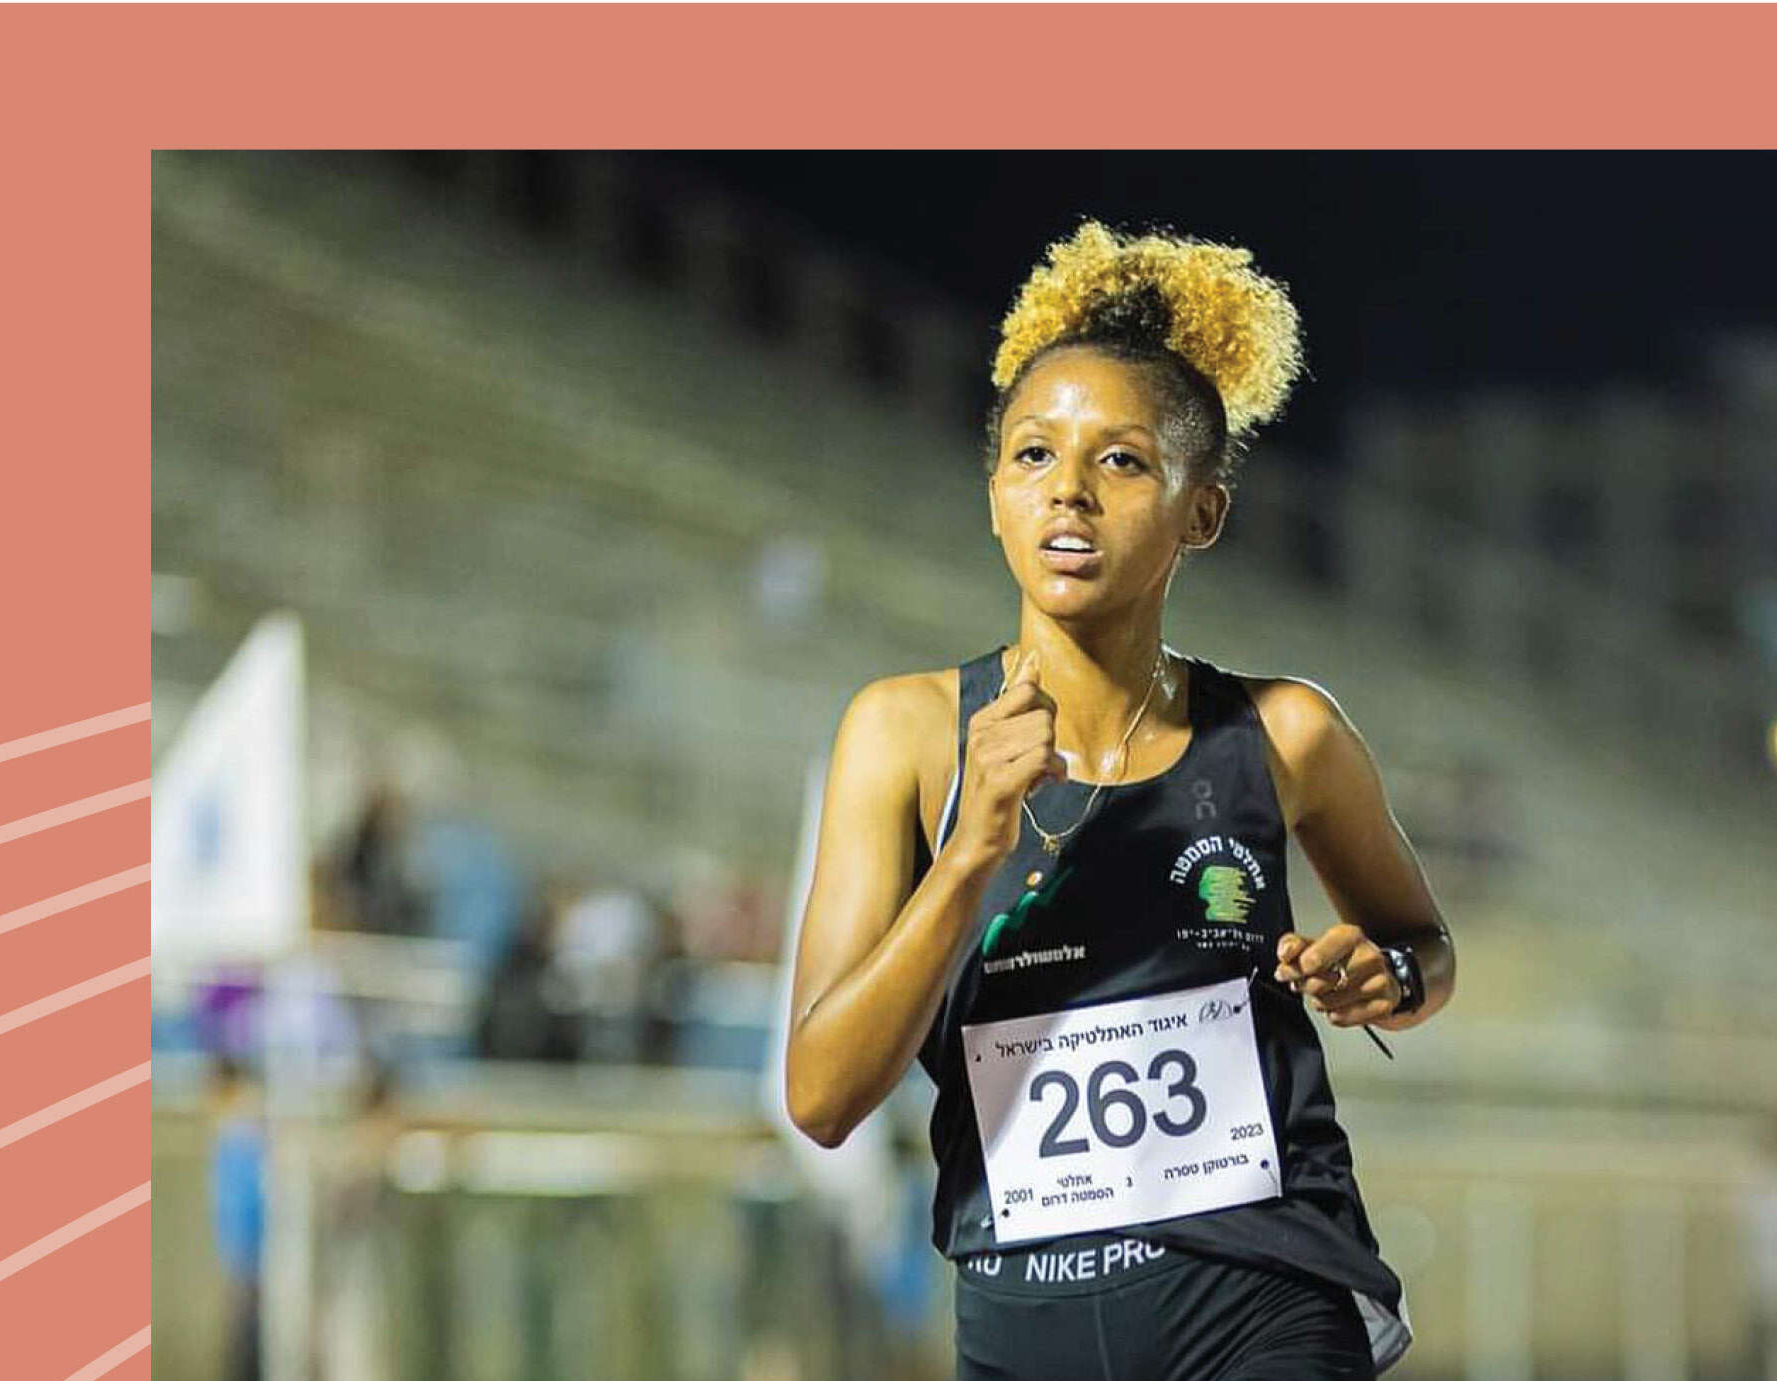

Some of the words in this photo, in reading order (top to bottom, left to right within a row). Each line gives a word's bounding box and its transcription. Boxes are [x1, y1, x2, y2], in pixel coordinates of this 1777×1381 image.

[1150, 1013, 1188, 1034] איגוד
[1058, 1022, 1144, 1053] האתלטיקה
[995, 1040, 1053, 1058] בישראל
[1029, 1048, 1208, 1159] 263
[1230, 1123, 1265, 1141] 2023
[1056, 1173, 1094, 1189] אתלטי
[1003, 1187, 1034, 1205] 2001
[1040, 1193, 1068, 1208] דרום
[1070, 1187, 1115, 1203] הסמטה
[1024, 1249, 1097, 1283] NIKE
